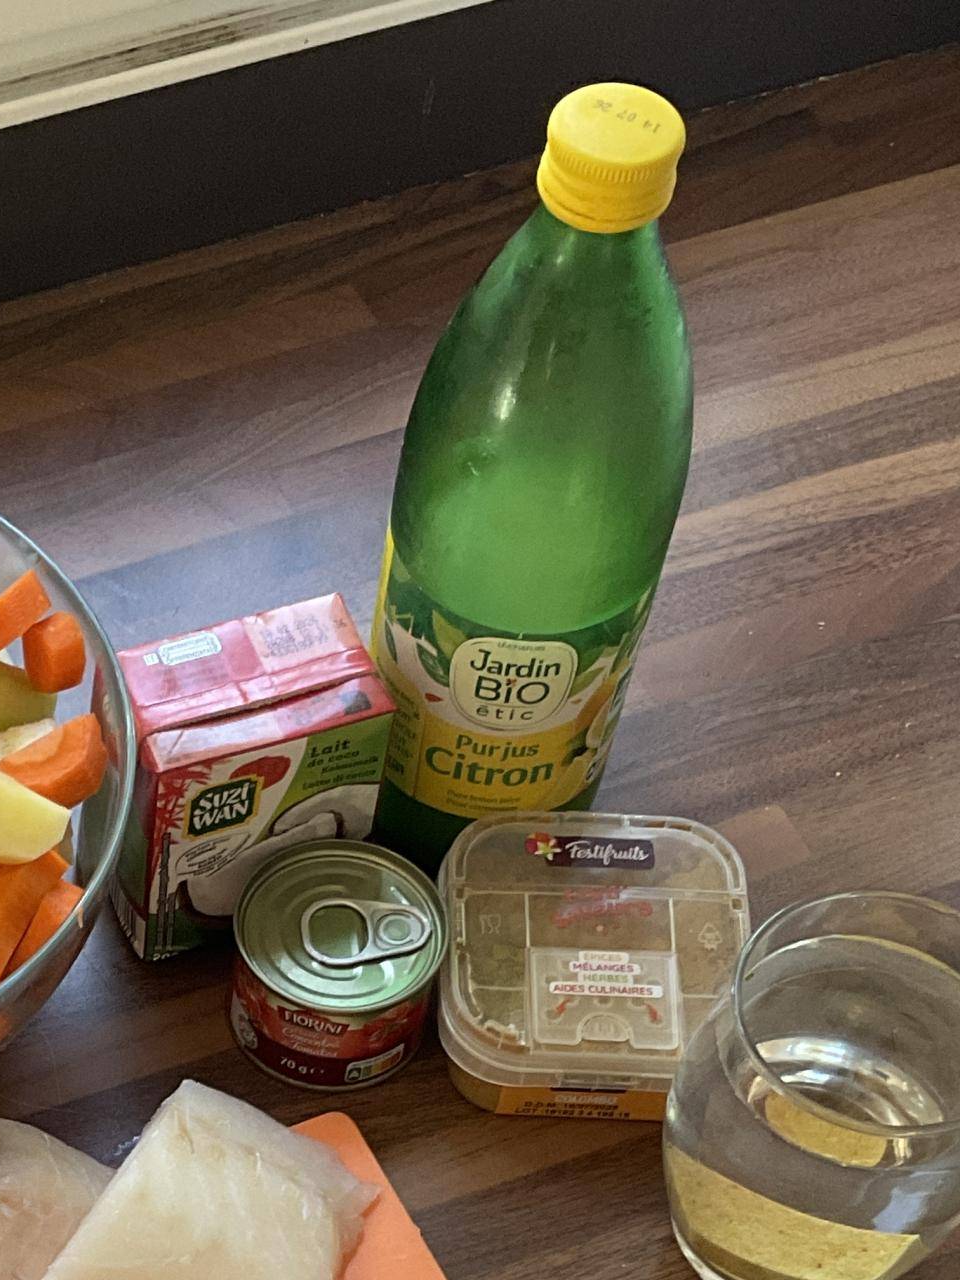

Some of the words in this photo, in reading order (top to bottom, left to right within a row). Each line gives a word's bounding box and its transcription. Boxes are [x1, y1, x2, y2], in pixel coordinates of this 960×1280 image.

[470, 649, 561, 678] Jardin
[311, 737, 350, 758] Lait
[456, 734, 500, 757] Pur
[501, 742, 539, 761] jus
[425, 746, 554, 787] Citron
[200, 782, 250, 808] SUZI
[193, 800, 249, 830] WAN
[565, 840, 649, 866] Festifruits
[573, 961, 634, 973] MÉLANGES
[553, 984, 585, 993] AIDES
[588, 985, 653, 996] CULINAIRES
[284, 1010, 342, 1034] FIORINI
[279, 1056, 296, 1069] 70
